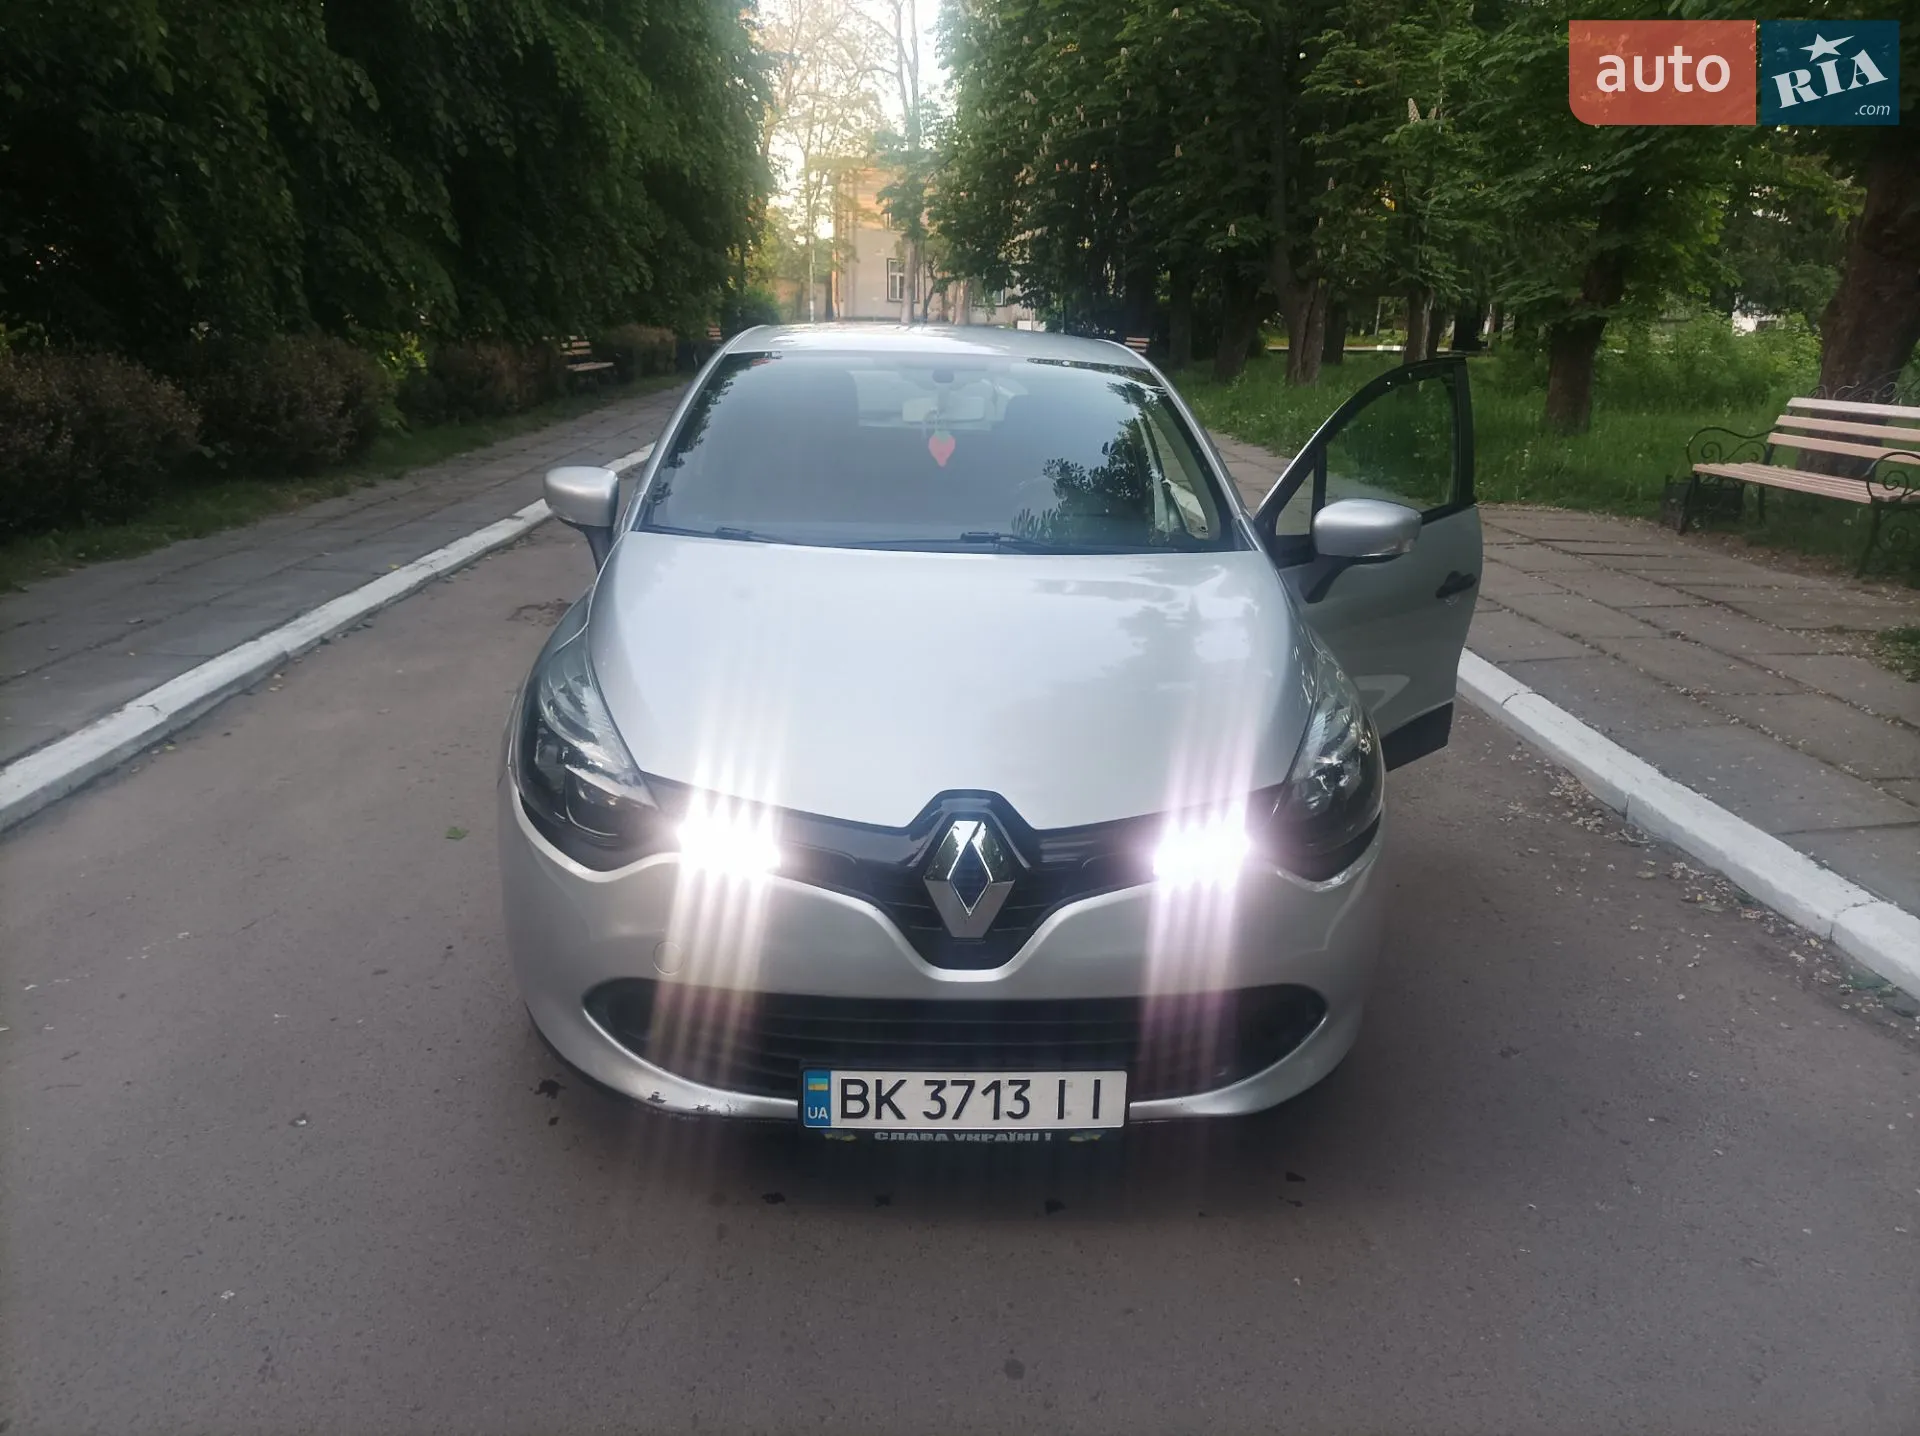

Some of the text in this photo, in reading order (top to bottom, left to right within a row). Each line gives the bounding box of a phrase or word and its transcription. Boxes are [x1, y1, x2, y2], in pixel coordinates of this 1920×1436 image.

[840, 1079, 907, 1120] BK
[922, 1079, 1031, 1120] 3713
[807, 1107, 828, 1120] UA
